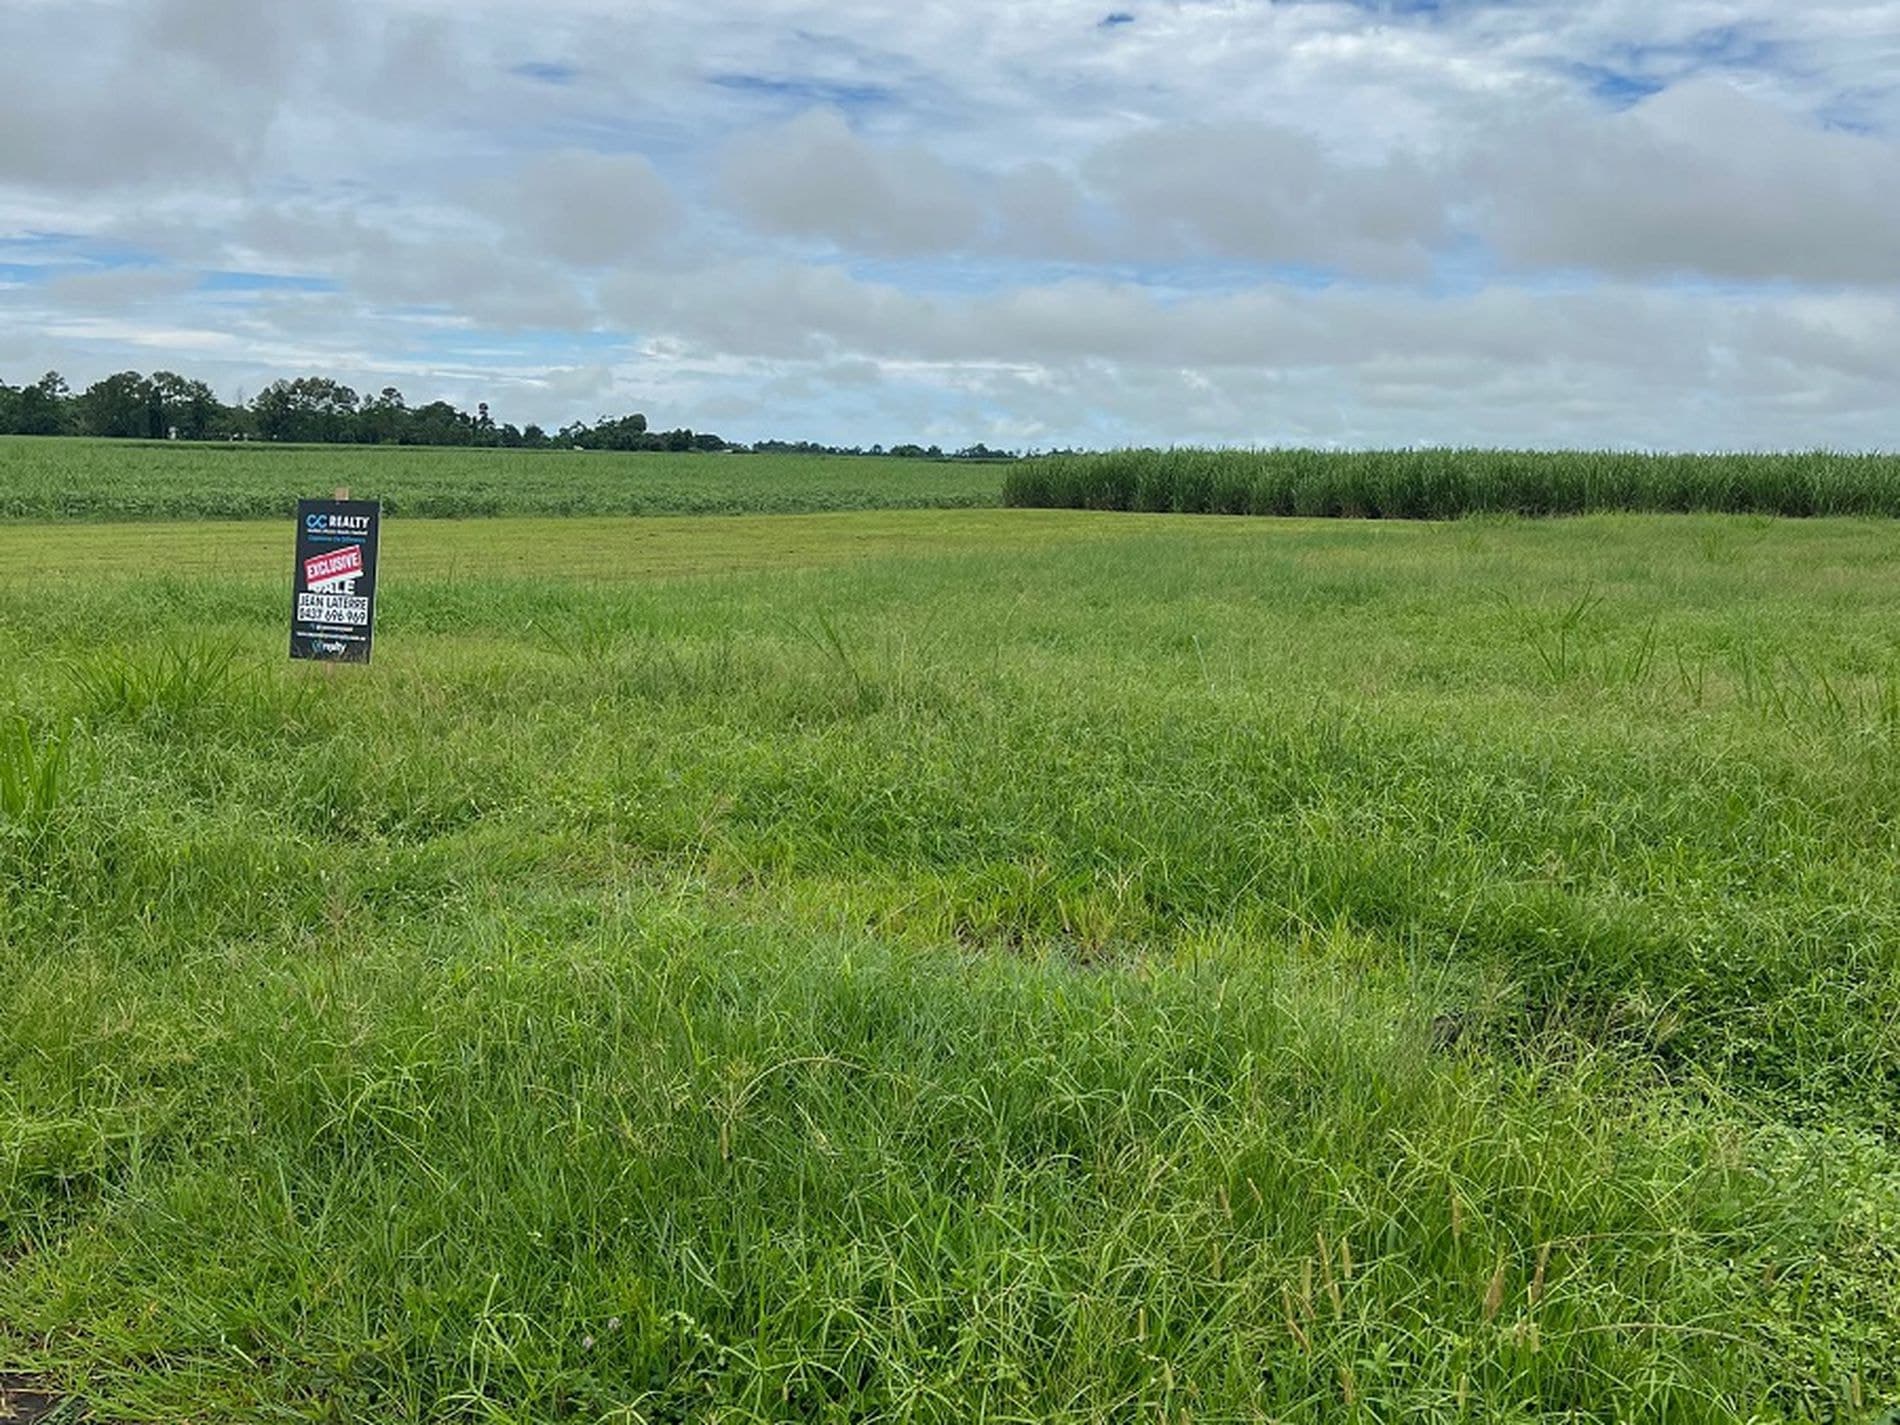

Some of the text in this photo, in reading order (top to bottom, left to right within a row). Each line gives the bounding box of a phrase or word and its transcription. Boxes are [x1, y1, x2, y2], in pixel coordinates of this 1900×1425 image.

[329, 515, 370, 528] REALTY
[307, 552, 360, 579] EXCLUSIVE
[300, 594, 366, 610] JEAN LATERRE
[300, 607, 366, 623] 0437 696 969
